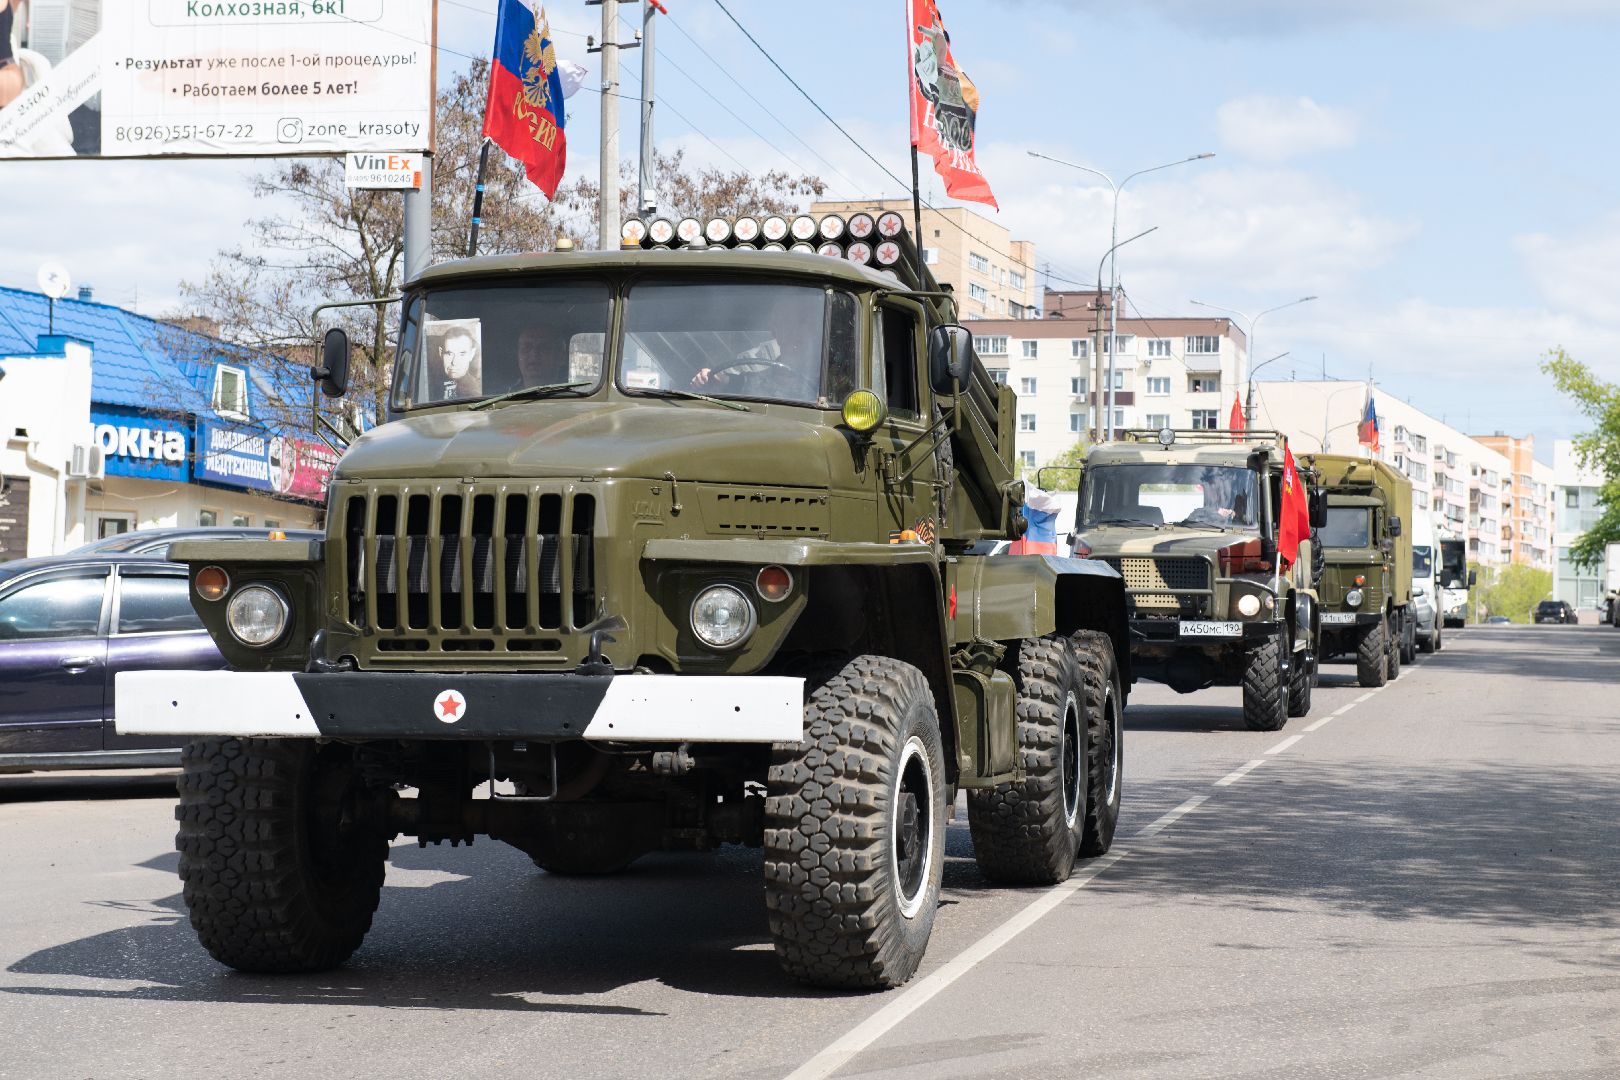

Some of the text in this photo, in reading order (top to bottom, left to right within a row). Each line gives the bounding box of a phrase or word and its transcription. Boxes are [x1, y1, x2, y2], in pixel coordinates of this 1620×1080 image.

[187, 1, 305, 18] Колхозная,
[125, 51, 418, 72] Результат уже после 1-ой процедуры!
[183, 80, 358, 97] Работаем более 5 лет!
[116, 124, 254, 143] 8(926)551-67-22
[308, 120, 420, 138] zone_krasoty
[353, 155, 411, 170] VinEx
[90, 423, 186, 461] окна
[205, 451, 269, 481] МЕДТЕХНИКА
